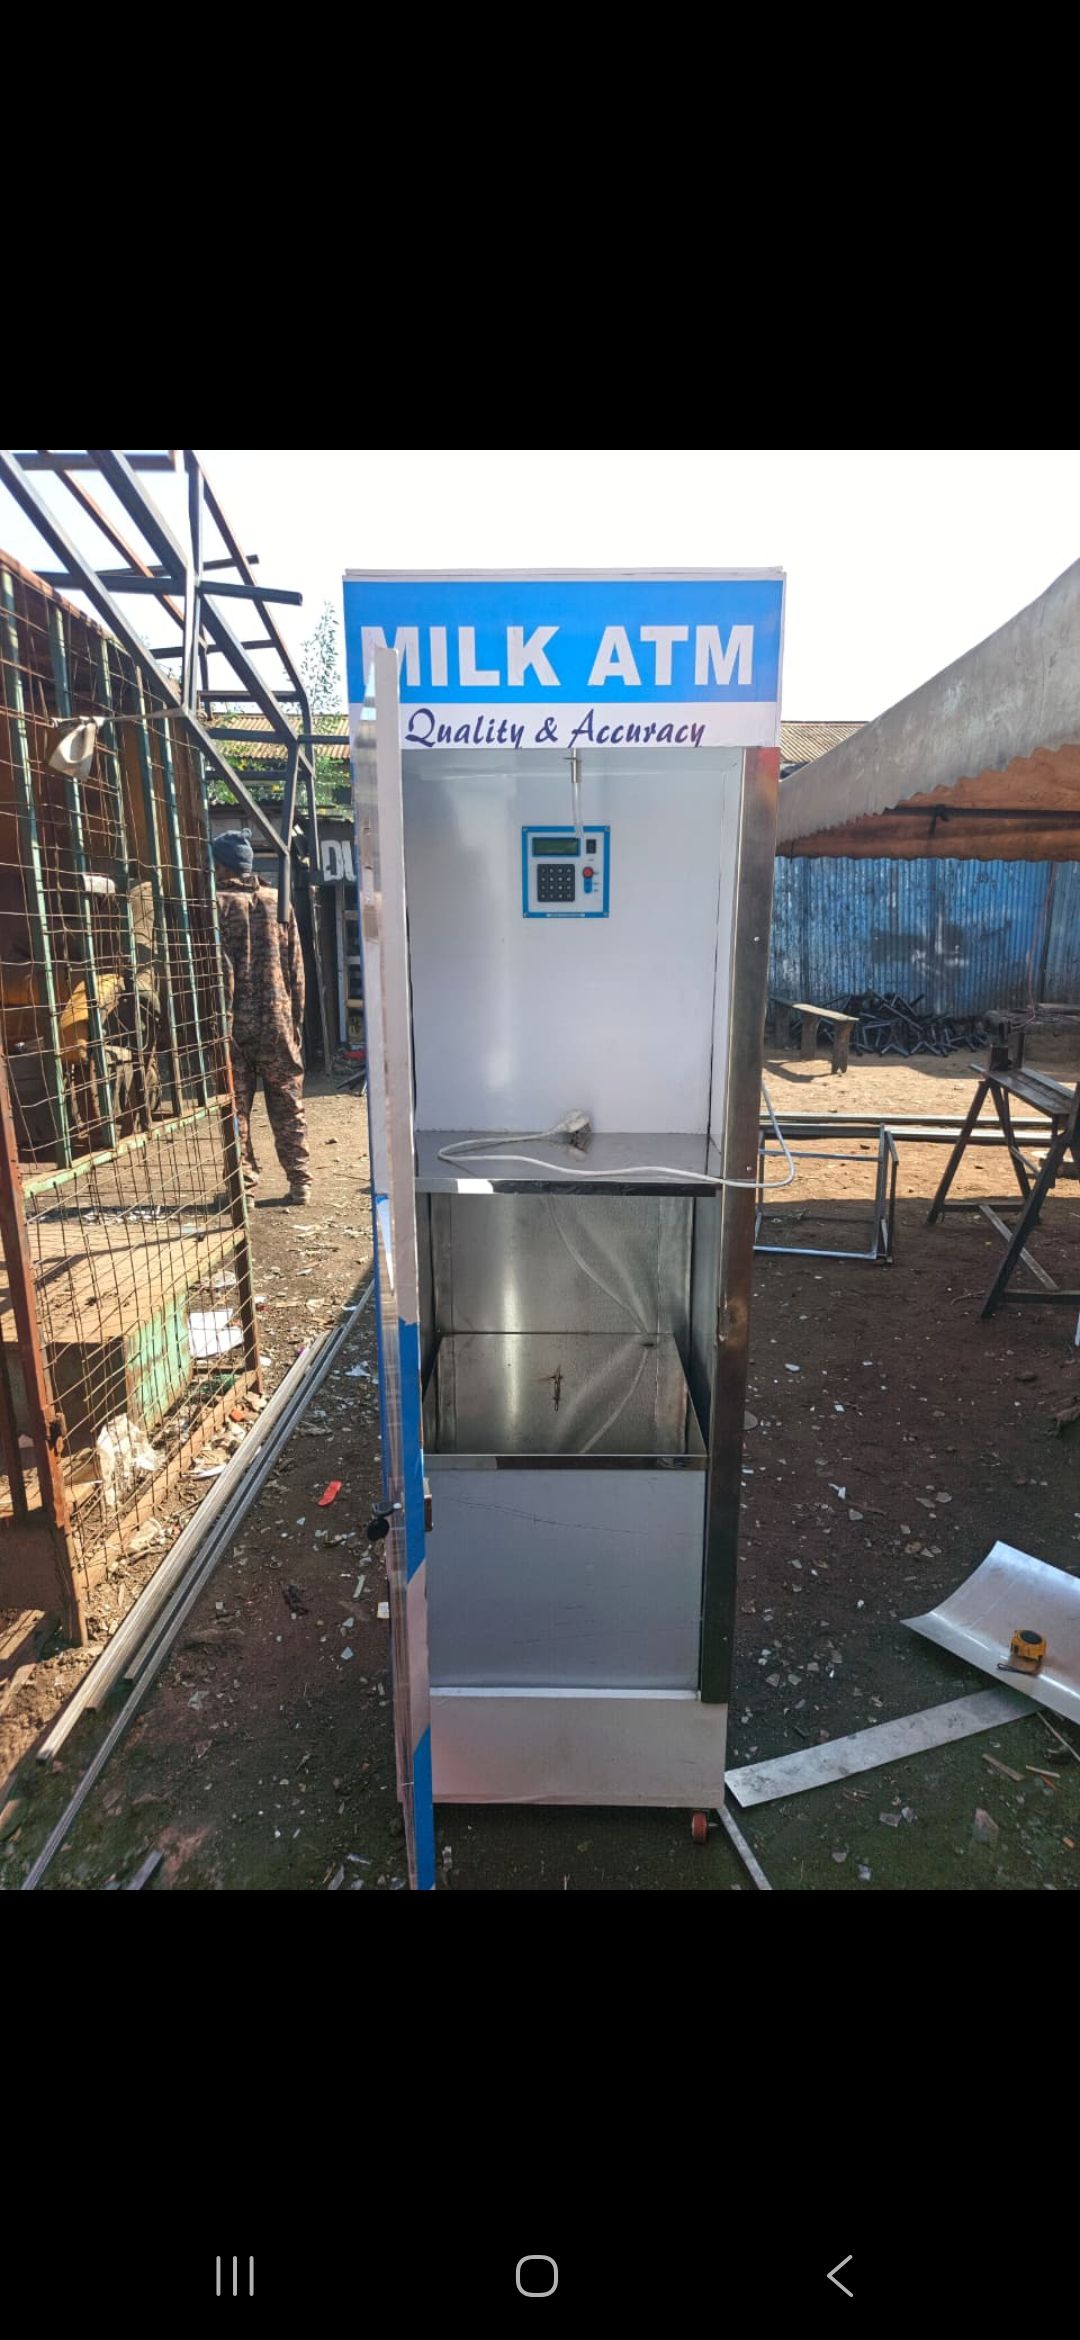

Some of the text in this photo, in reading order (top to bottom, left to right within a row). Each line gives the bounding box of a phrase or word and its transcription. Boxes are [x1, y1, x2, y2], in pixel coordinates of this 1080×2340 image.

[362, 625, 755, 686] MILK ATM
[405, 708, 706, 748] Quality & Accuracy
